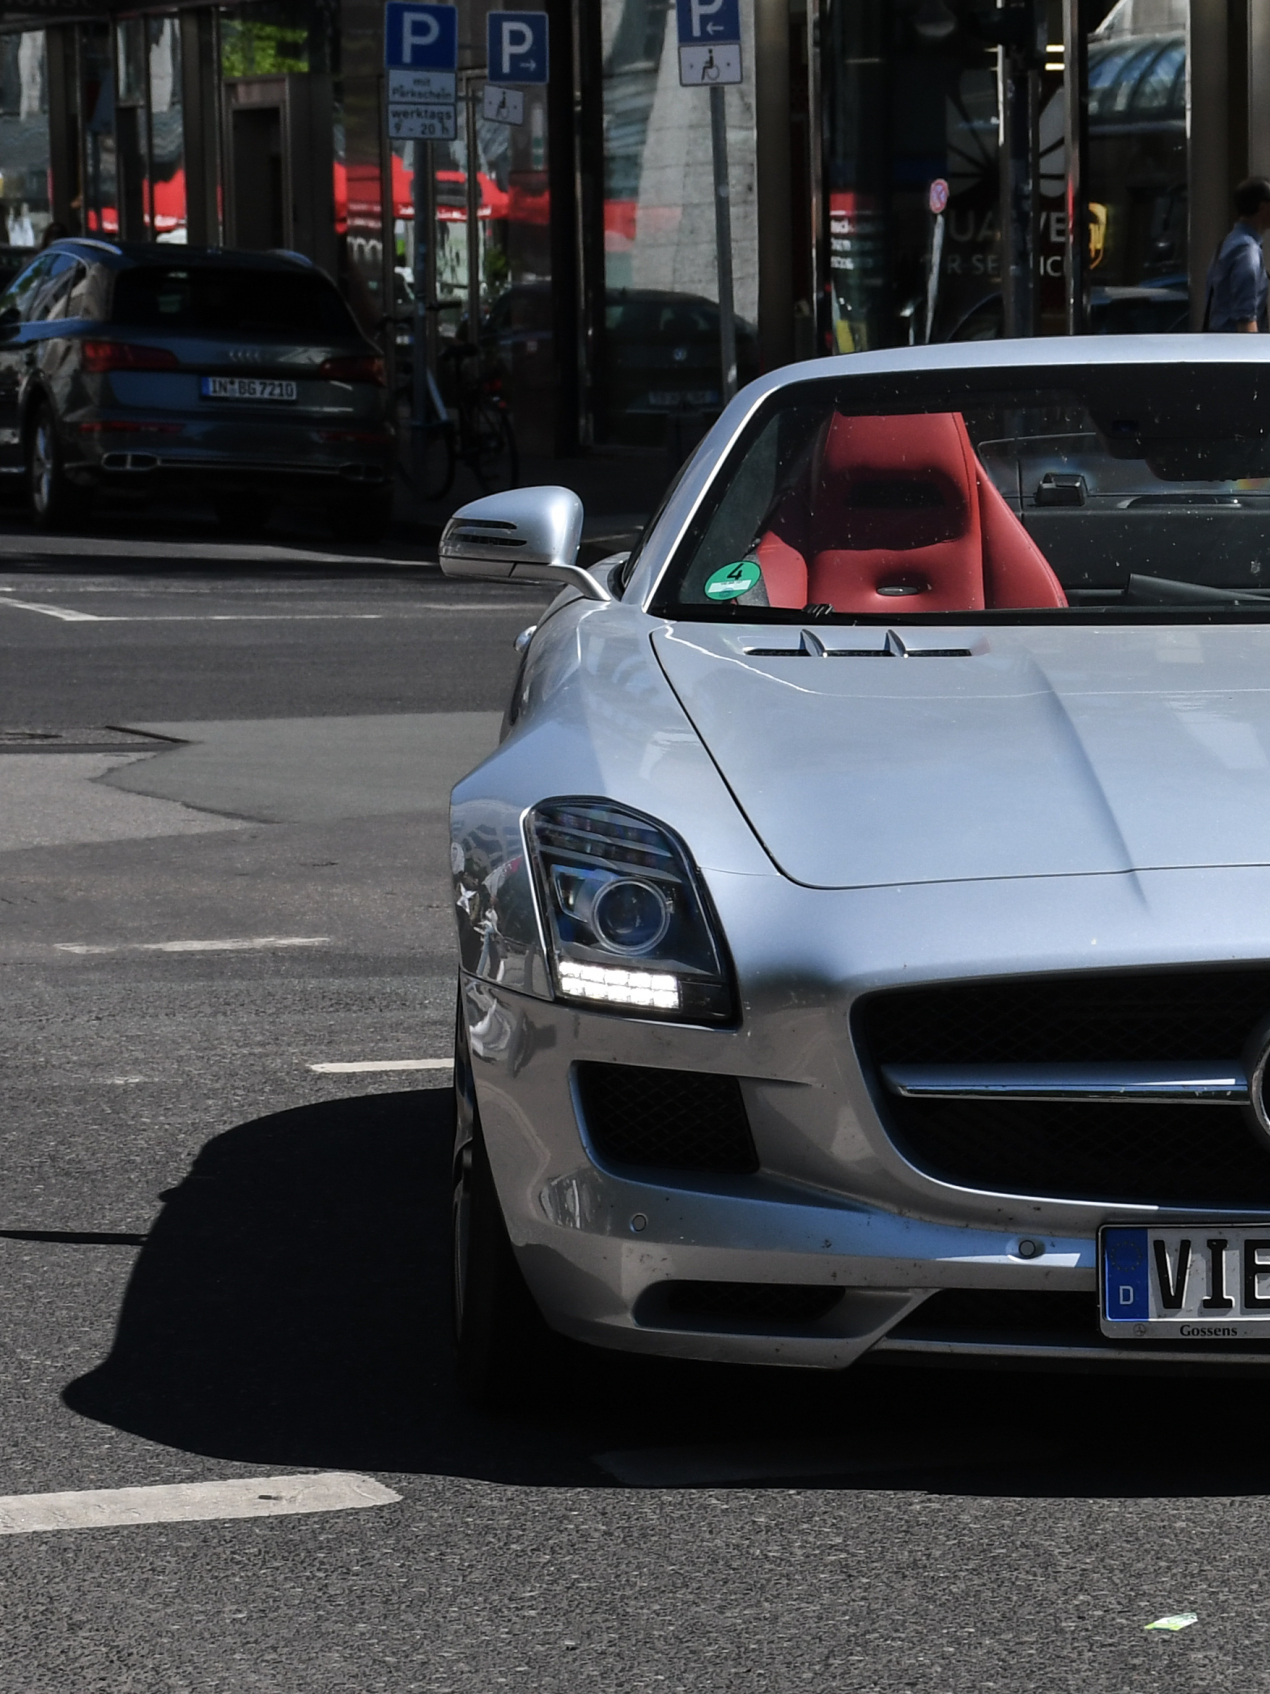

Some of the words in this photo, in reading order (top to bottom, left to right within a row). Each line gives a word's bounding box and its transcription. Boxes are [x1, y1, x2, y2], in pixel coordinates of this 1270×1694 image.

[402, 12, 440, 64] P
[501, 21, 534, 74] P
[413, 76, 431, 87] mit
[390, 106, 452, 123] werktags
[420, 122, 436, 135] 20
[440, 122, 449, 135] h
[212, 380, 227, 394] IN
[238, 381, 256, 396] BG
[259, 382, 294, 397] 7210
[727, 563, 744, 580] 4
[1119, 1285, 1134, 1305] D
[1180, 1324, 1238, 1336] Gossens
